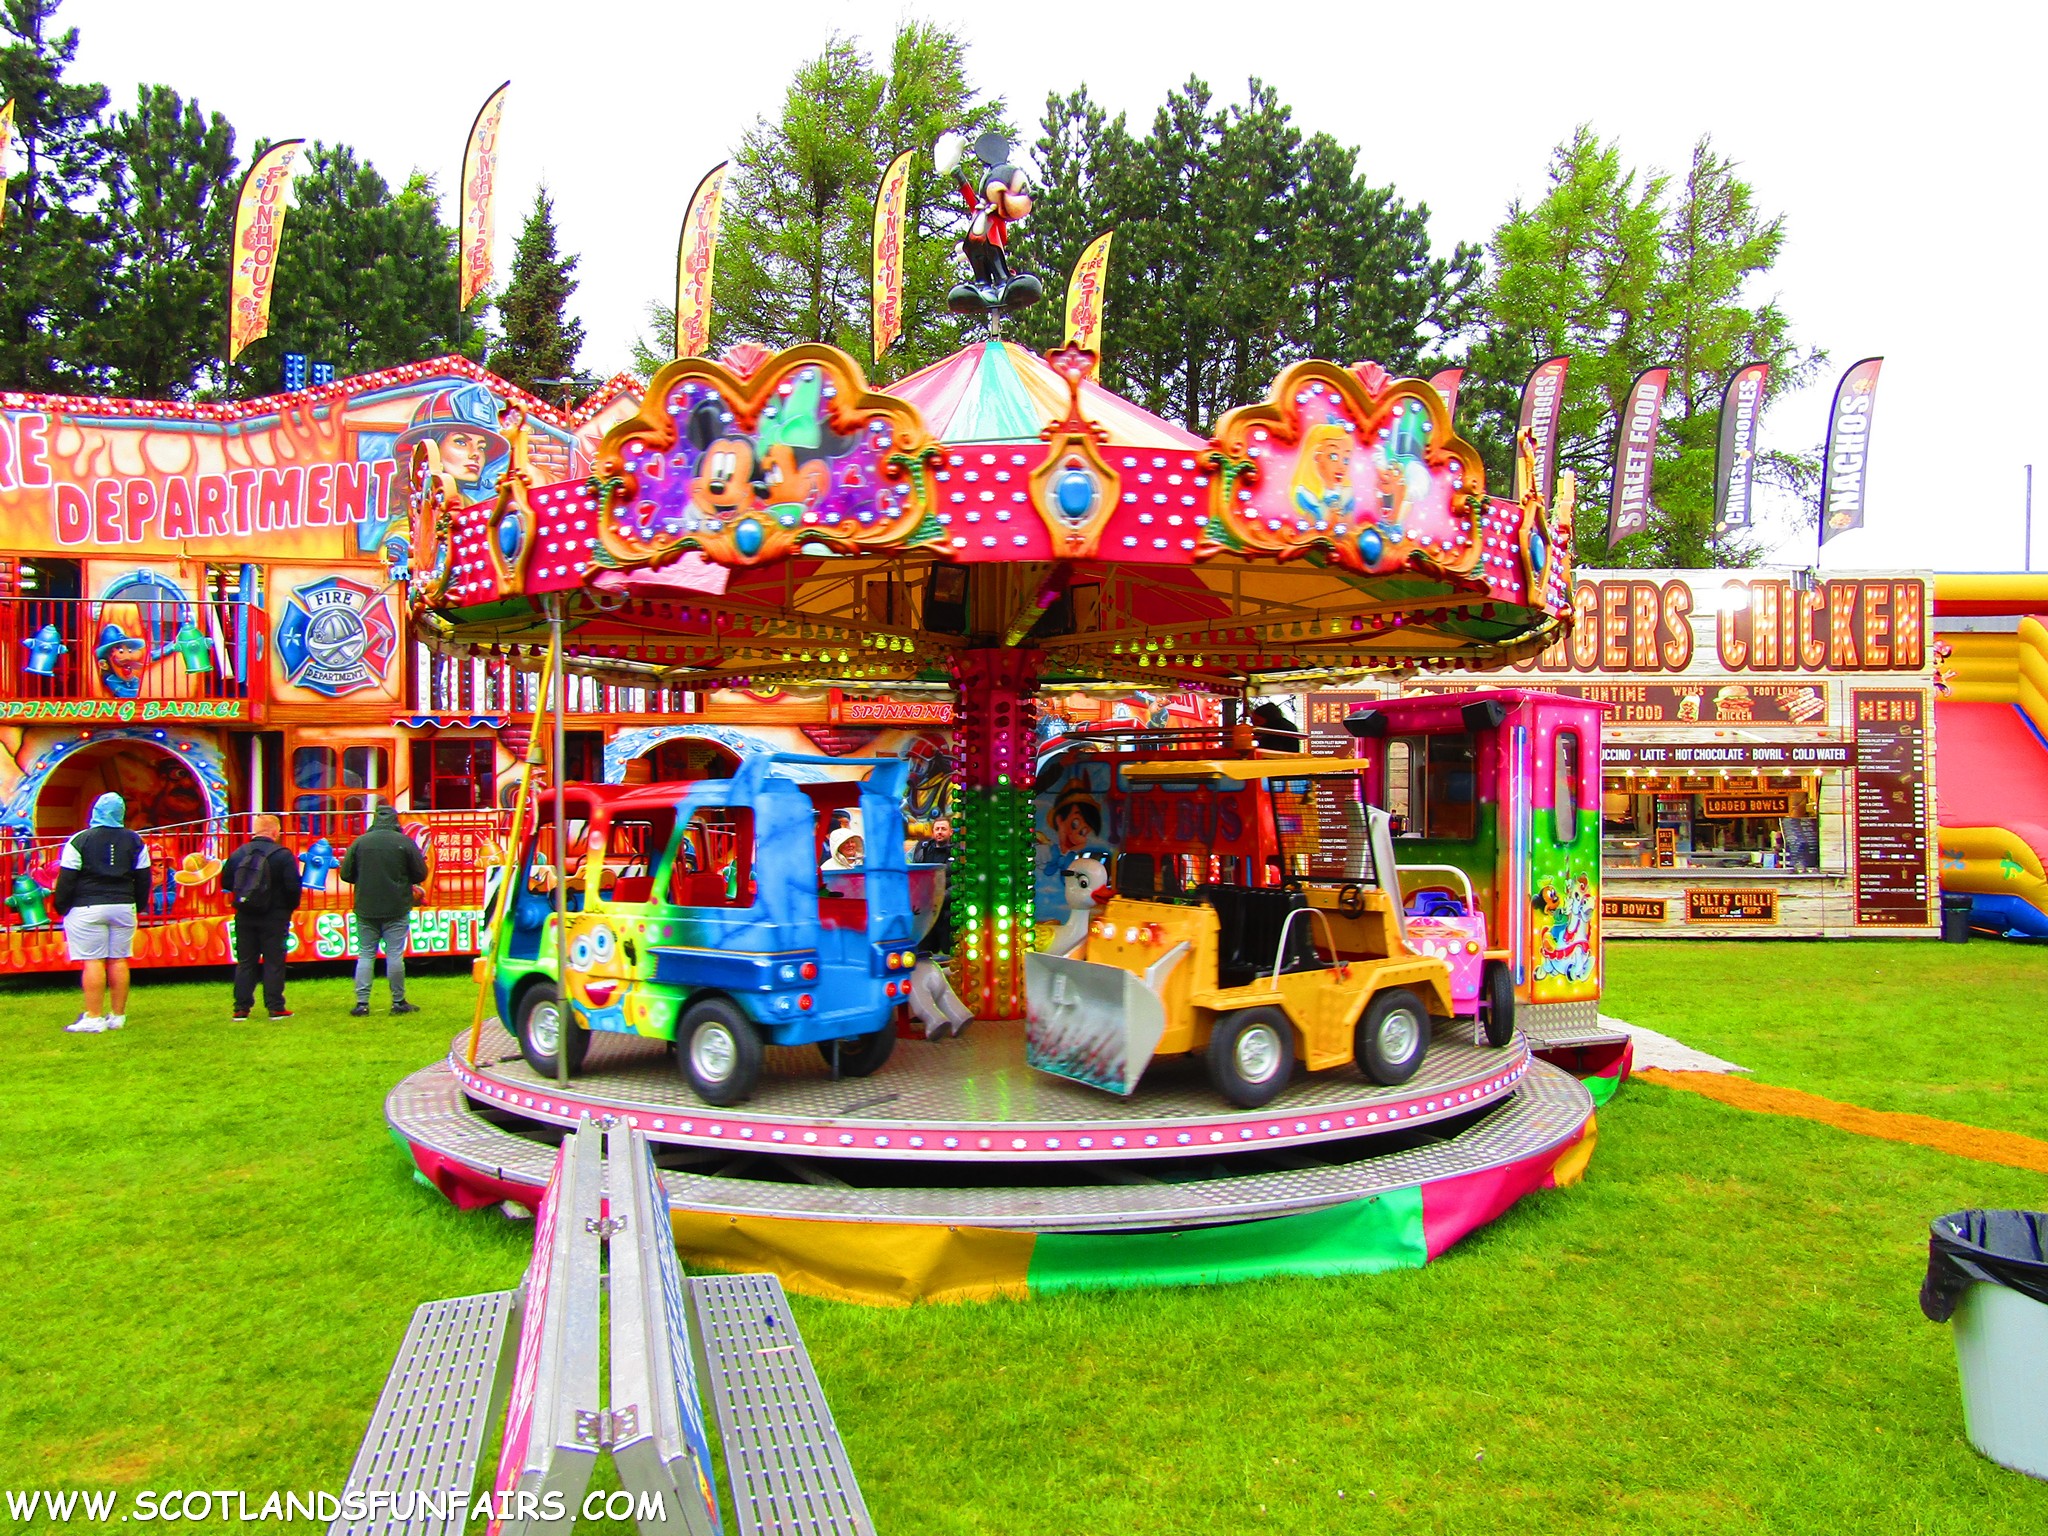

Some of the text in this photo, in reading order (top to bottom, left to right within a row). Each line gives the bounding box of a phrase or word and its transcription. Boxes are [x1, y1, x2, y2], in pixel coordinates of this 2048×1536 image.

[0, 413, 52, 493] RE
[1617, 384, 1659, 528] STREET FOOD
[1829, 395, 1870, 512] NACHOS
[54, 458, 398, 546] DEPARTMENT
[315, 591, 353, 606] FIRE
[1719, 581, 1920, 669] CHICKEN
[306, 669, 364, 682] DEPARTMENT
[1581, 687, 1647, 702] FUNTIME
[1673, 686, 1704, 697] WRAPS
[1753, 686, 1775, 697] FOOT
[142, 701, 241, 720] BARREL
[851, 703, 952, 722] SPINNING
[1626, 705, 1663, 721] FOOD
[1716, 711, 1753, 721] CHICKEN
[1858, 700, 1917, 721] MENU
[1640, 748, 1666, 760] LATTE
[1675, 748, 1693, 760] HOT
[1694, 748, 1743, 760] CHOCOLATE
[1752, 748, 1784, 760] BOVRIL
[1792, 748, 1815, 760] COLD
[1816, 748, 1846, 760] WATER
[1708, 799, 1785, 812] LOADED BOWLS
[1692, 894, 1771, 906] SALT & CHILLI
[1622, 903, 1660, 916] BOWLS
[1742, 906, 1761, 914] CHIPS
